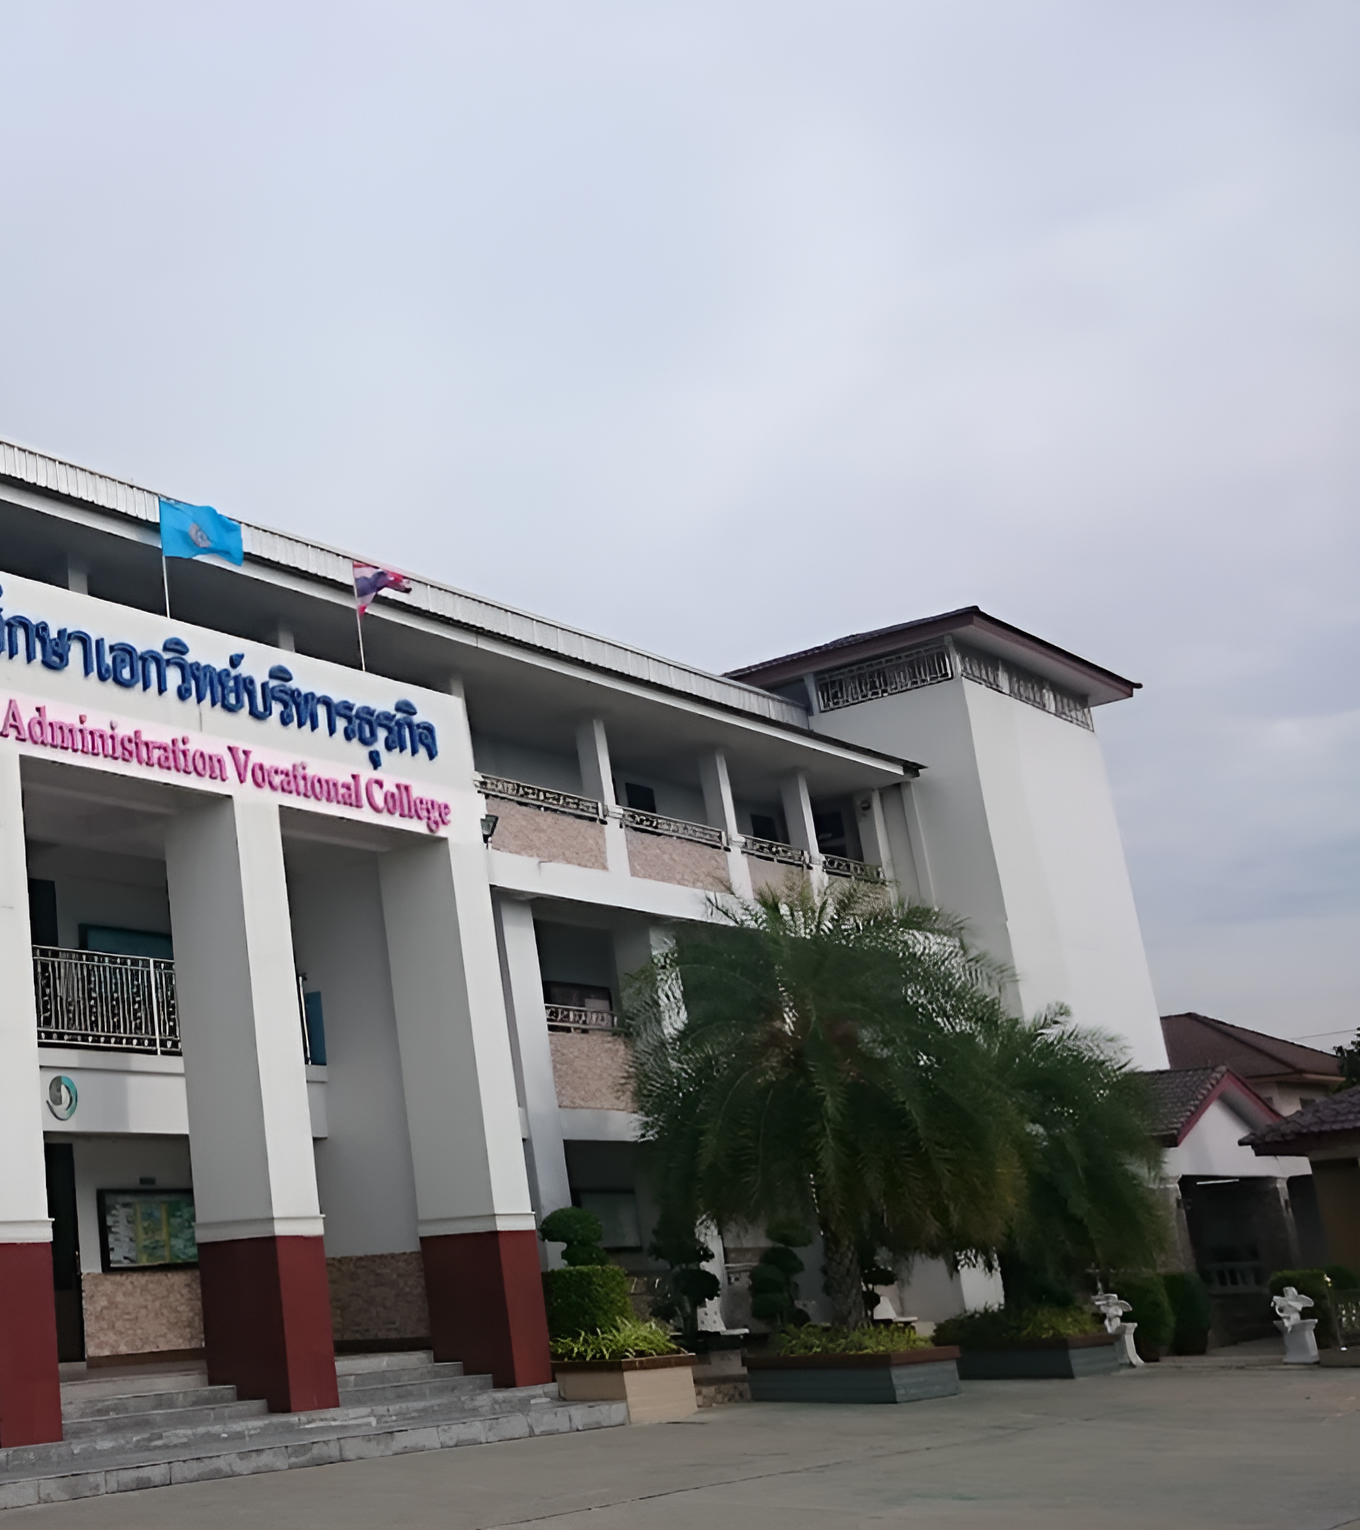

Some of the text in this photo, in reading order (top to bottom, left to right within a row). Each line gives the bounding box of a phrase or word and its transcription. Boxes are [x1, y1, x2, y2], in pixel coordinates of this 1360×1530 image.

[0, 698, 228, 782] Administration
[227, 745, 364, 808] Vocational
[365, 778, 452, 833] College
